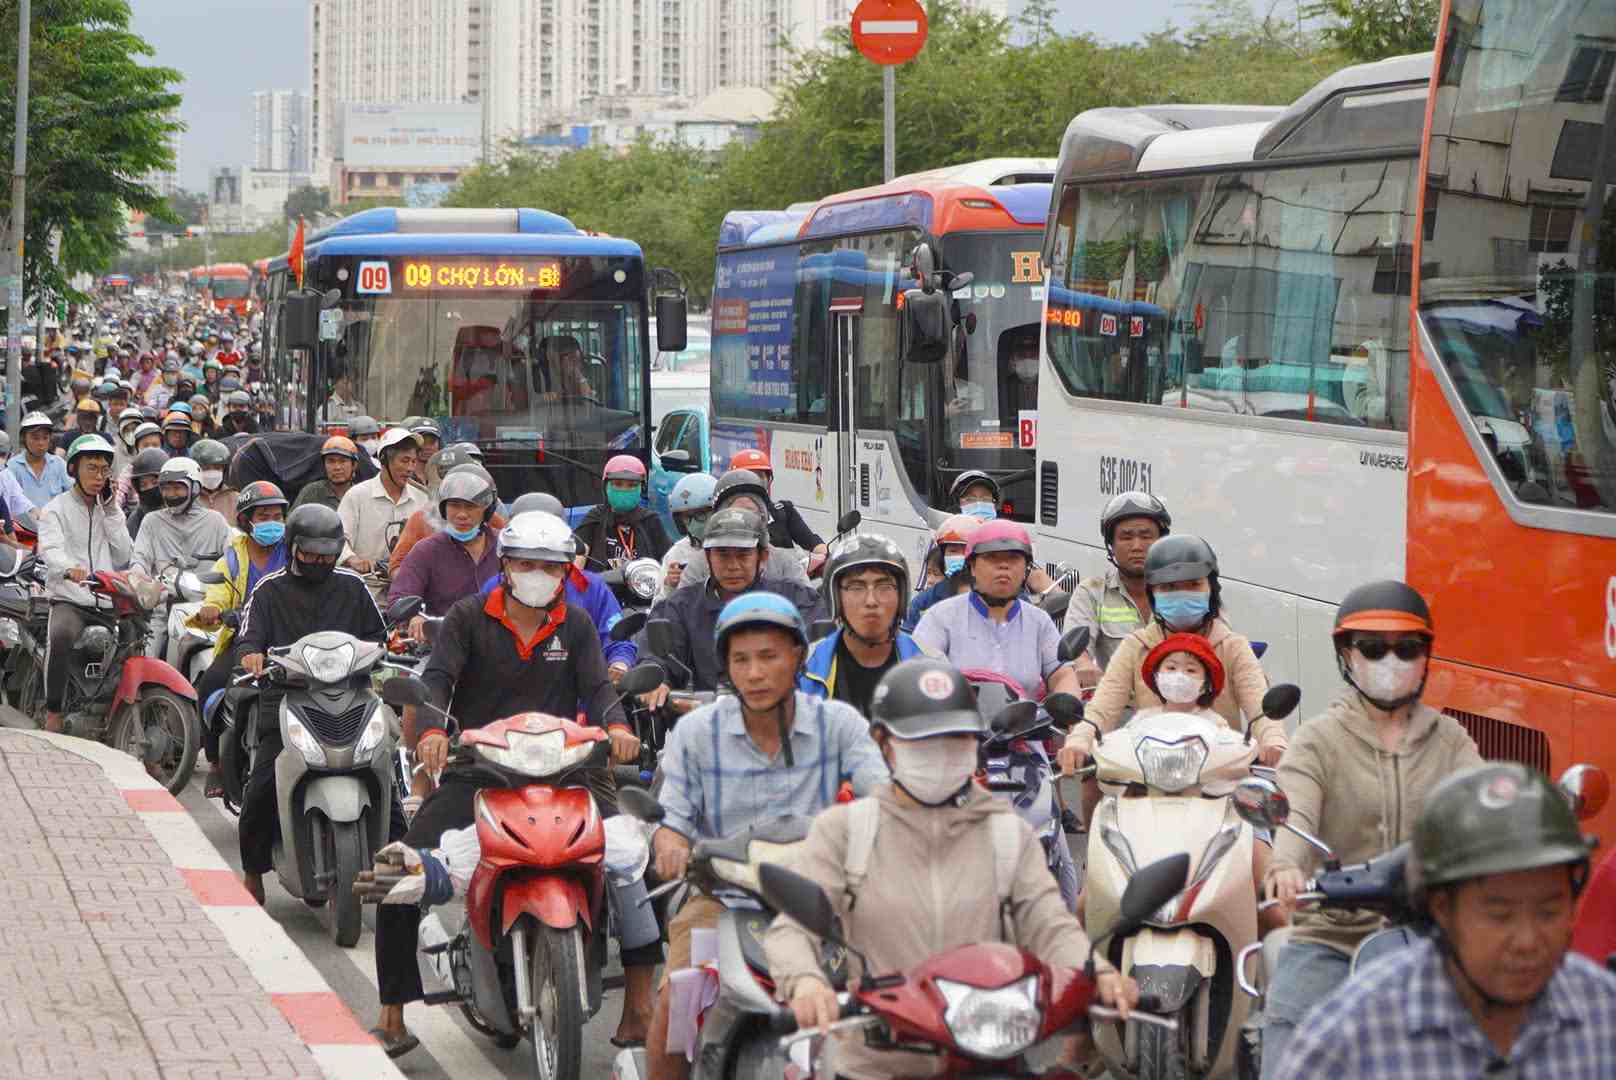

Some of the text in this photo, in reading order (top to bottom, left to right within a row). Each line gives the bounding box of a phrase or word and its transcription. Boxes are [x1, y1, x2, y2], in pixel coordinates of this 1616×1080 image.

[361, 267, 387, 290] 09
[405, 263, 431, 286] 09
[437, 267, 480, 287] CHỢ
[483, 264, 523, 286] LỚN
[1020, 419, 1039, 448] B
